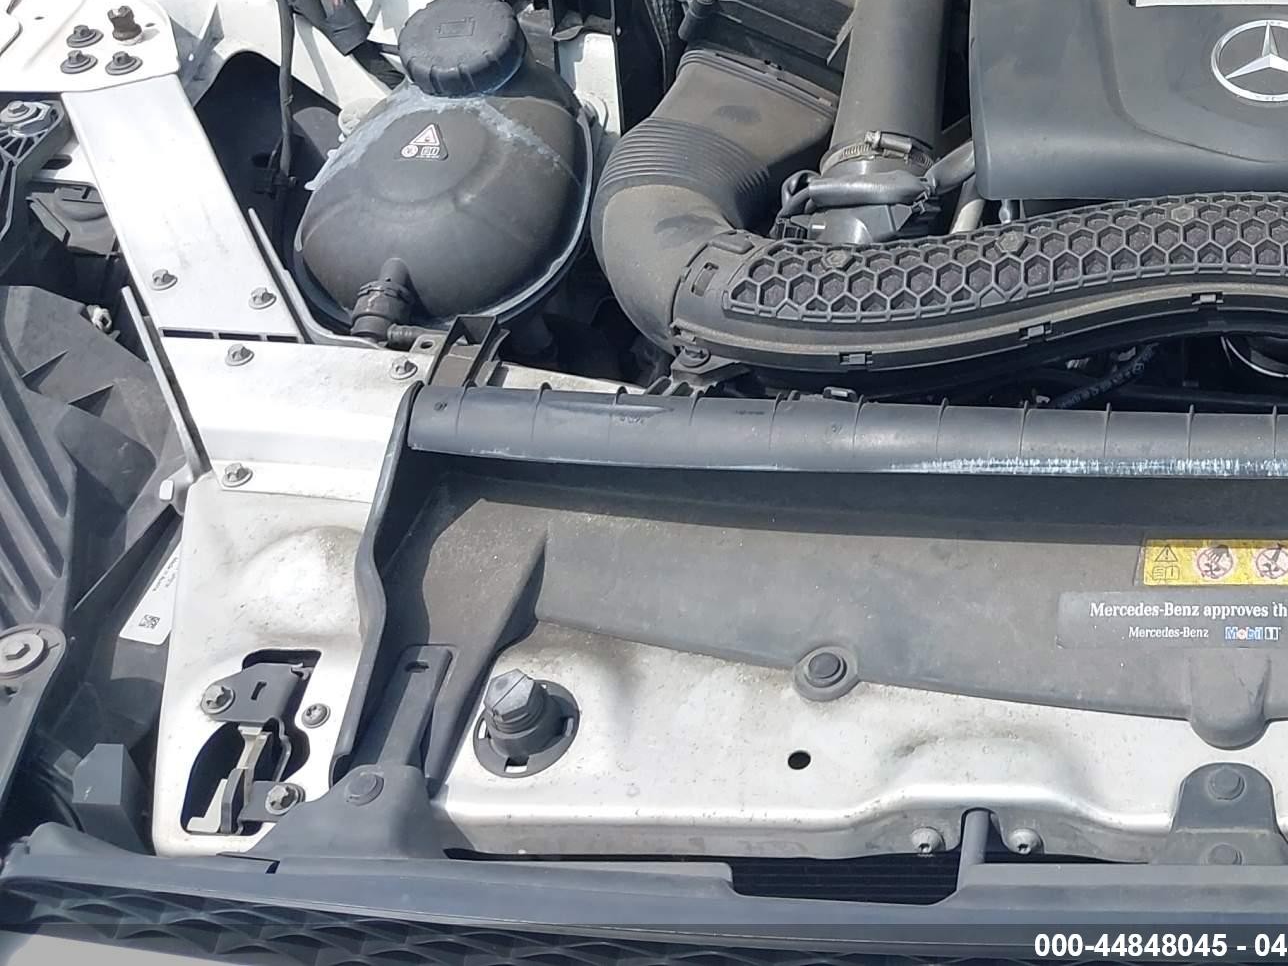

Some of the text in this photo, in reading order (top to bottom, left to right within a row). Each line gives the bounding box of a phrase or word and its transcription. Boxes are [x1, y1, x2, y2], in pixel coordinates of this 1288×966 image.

[1090, 602, 1200, 617] Mercedes-Benz
[1203, 605, 1269, 620] approves
[1128, 626, 1209, 638] Mercedes-Benz
[1225, 626, 1263, 640] Mobil
